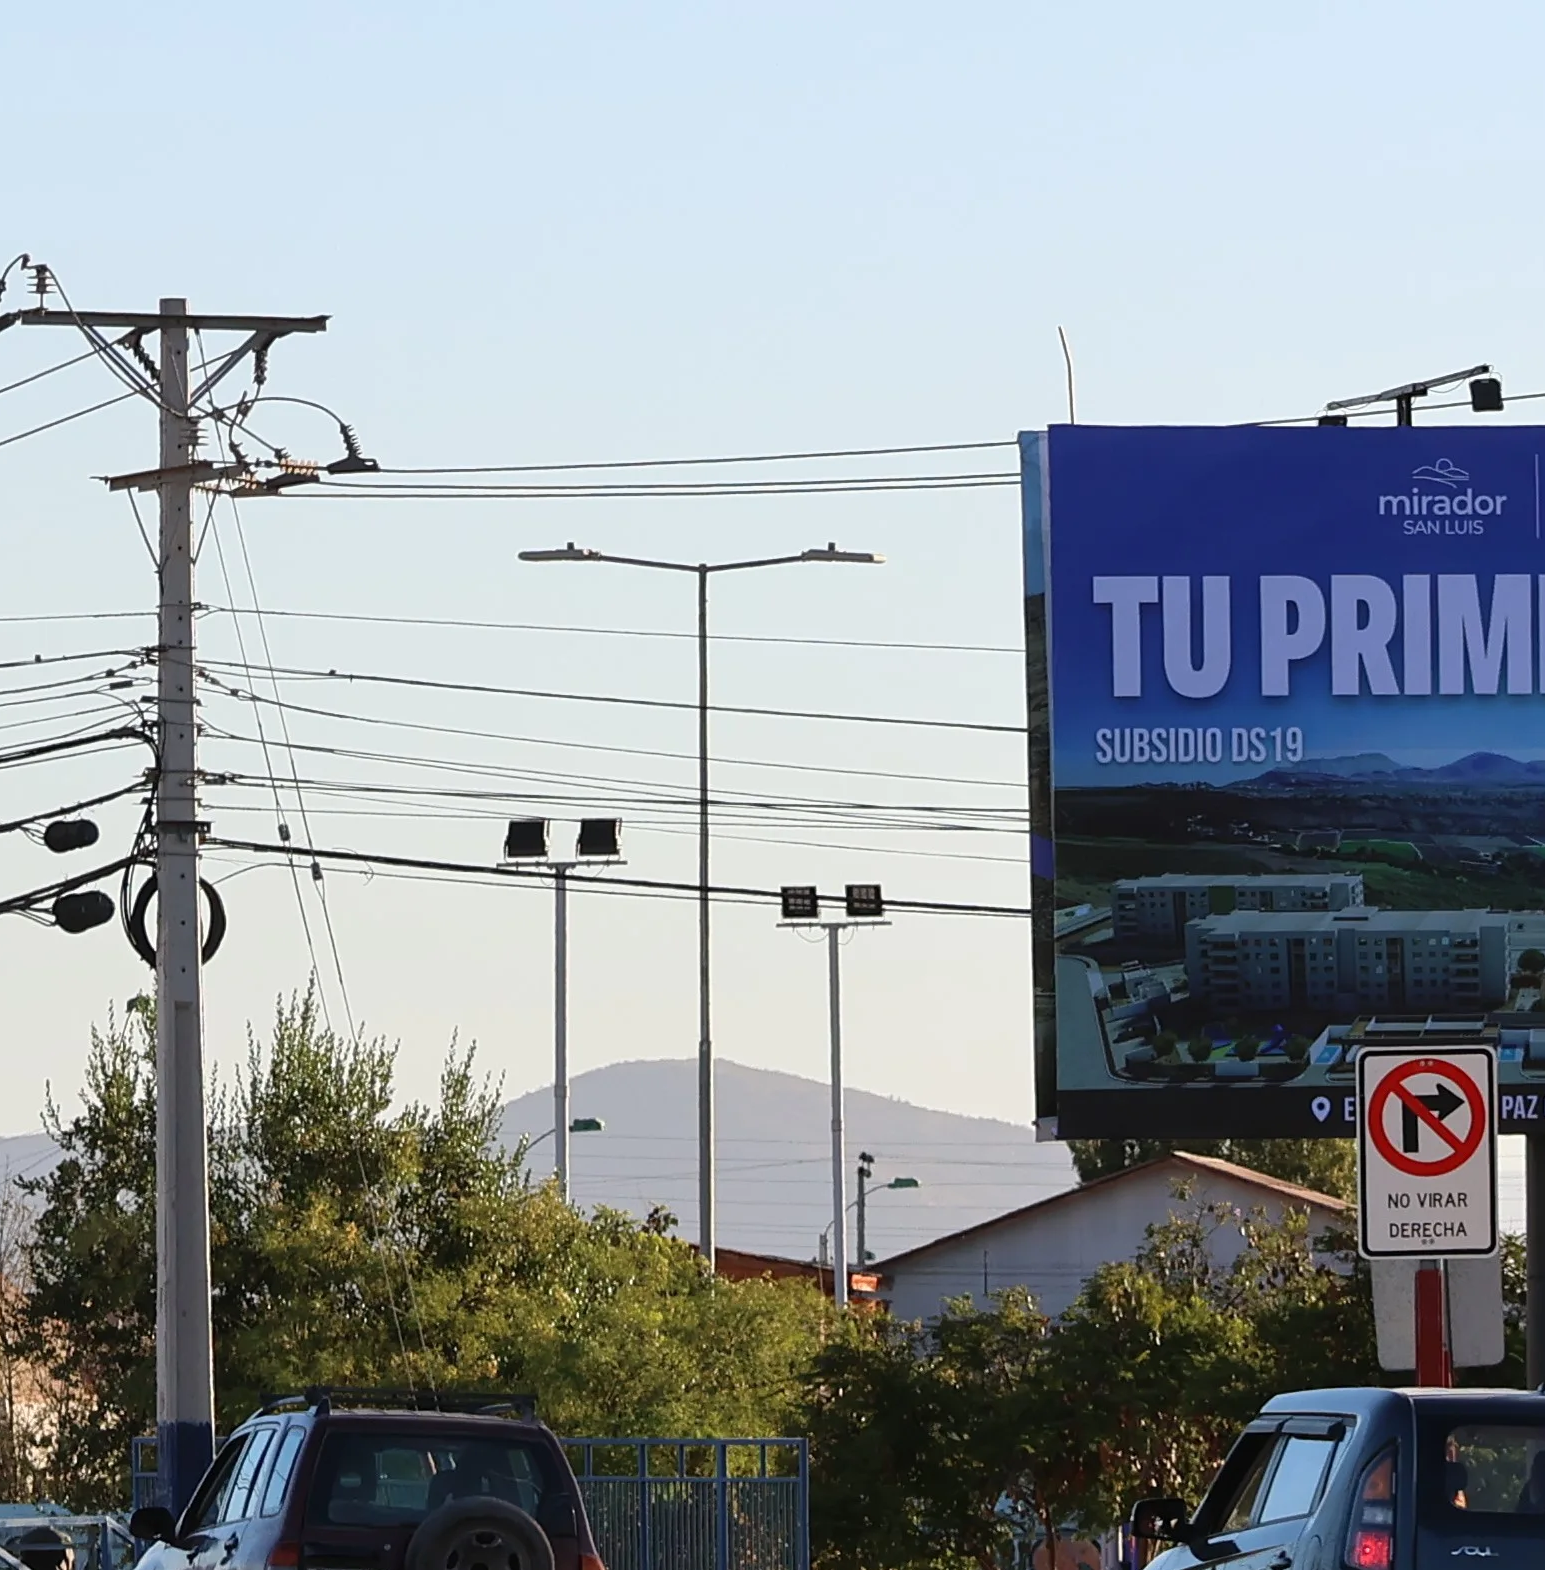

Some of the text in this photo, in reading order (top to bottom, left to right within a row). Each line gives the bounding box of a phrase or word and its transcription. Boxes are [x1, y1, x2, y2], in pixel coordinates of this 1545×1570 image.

[1378, 487, 1508, 515] mirador
[1403, 520, 1484, 536] SAN LUIS
[1092, 575, 1232, 699] TU
[1094, 727, 1223, 764] SUBSIDIO
[1501, 1095, 1538, 1120] PAZ
[1387, 1192, 1469, 1209] NO VIRAR
[1388, 1222, 1468, 1239] DERECHA
